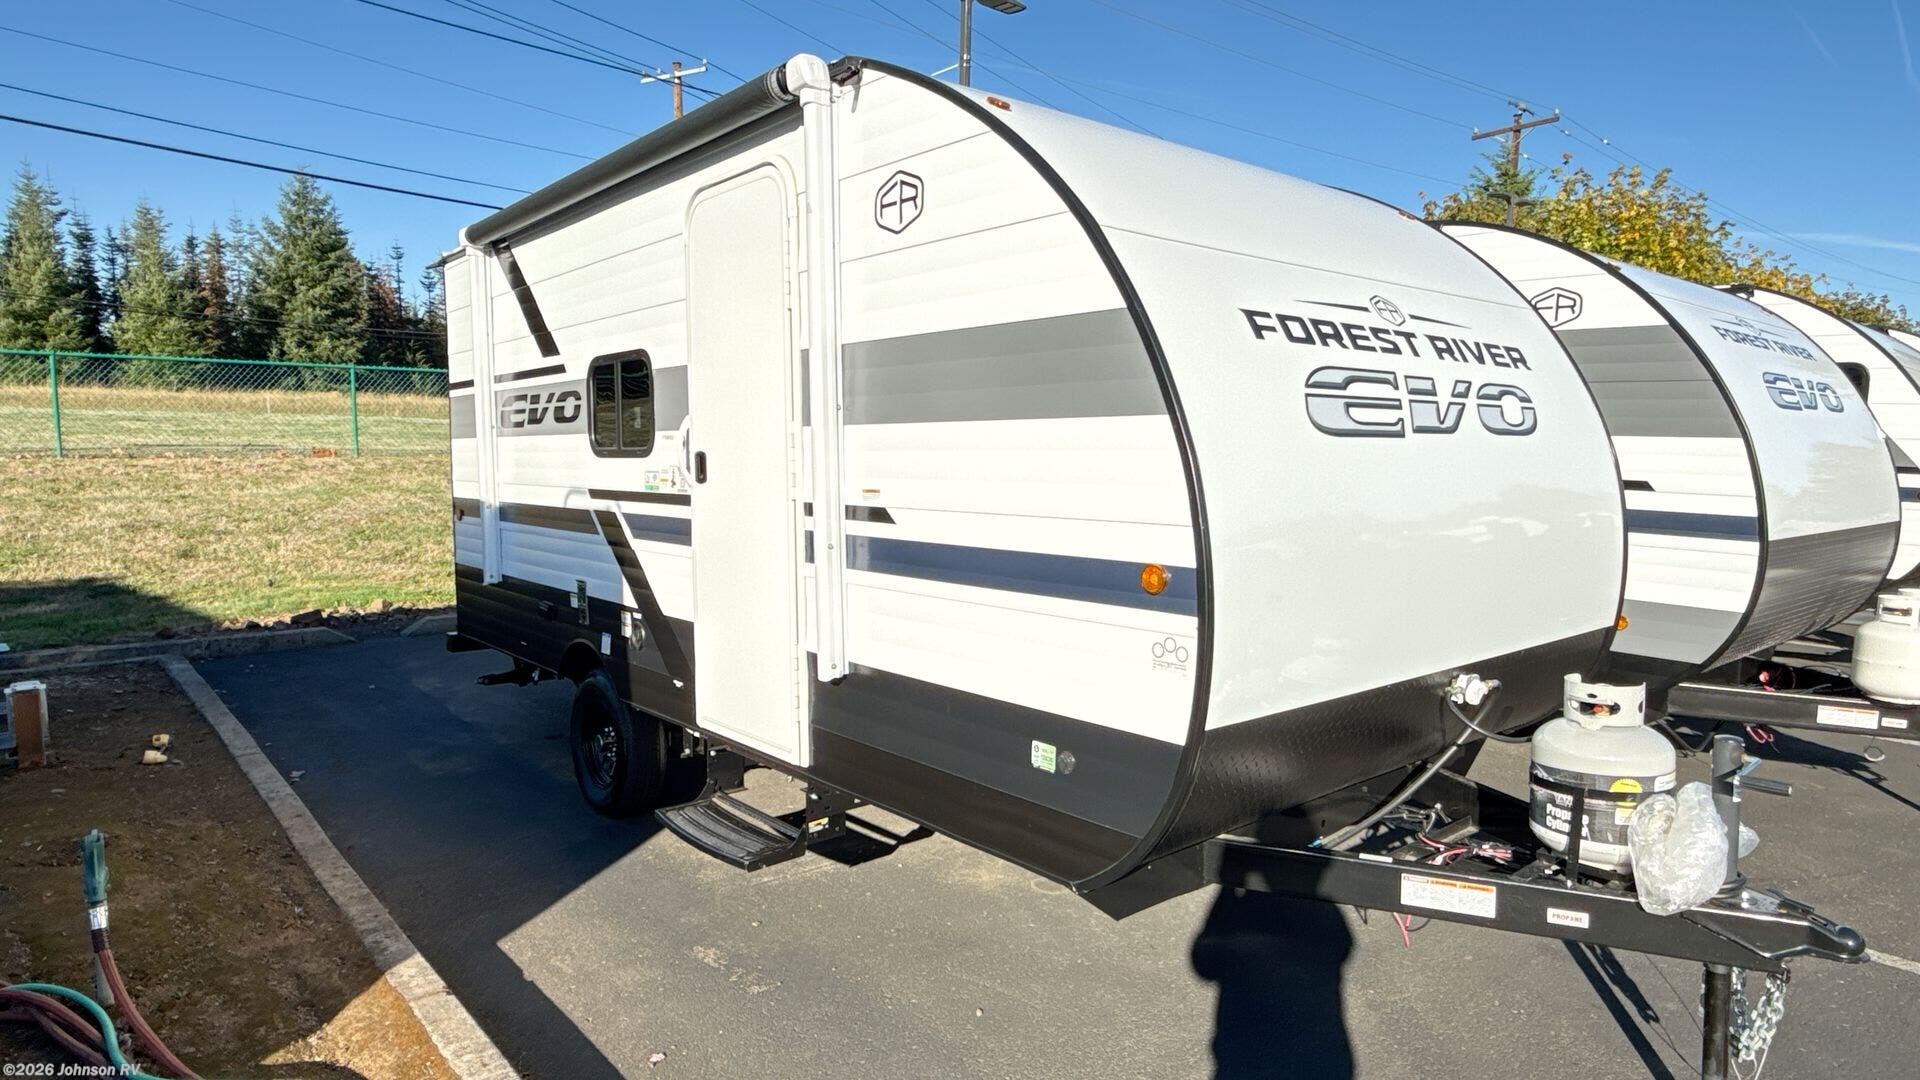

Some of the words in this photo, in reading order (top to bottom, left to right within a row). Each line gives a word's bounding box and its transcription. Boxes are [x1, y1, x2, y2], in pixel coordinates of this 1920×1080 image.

[1237, 307, 1421, 357] FOREST
[1423, 334, 1533, 372] RIVER
[1711, 325, 1777, 352] FOREST
[1772, 339, 1818, 362] RIVER
[501, 389, 582, 428] EVO
[1304, 365, 1538, 439] EVO
[1762, 371, 1845, 413] EVO
[1552, 913, 1583, 923] PROPANE
